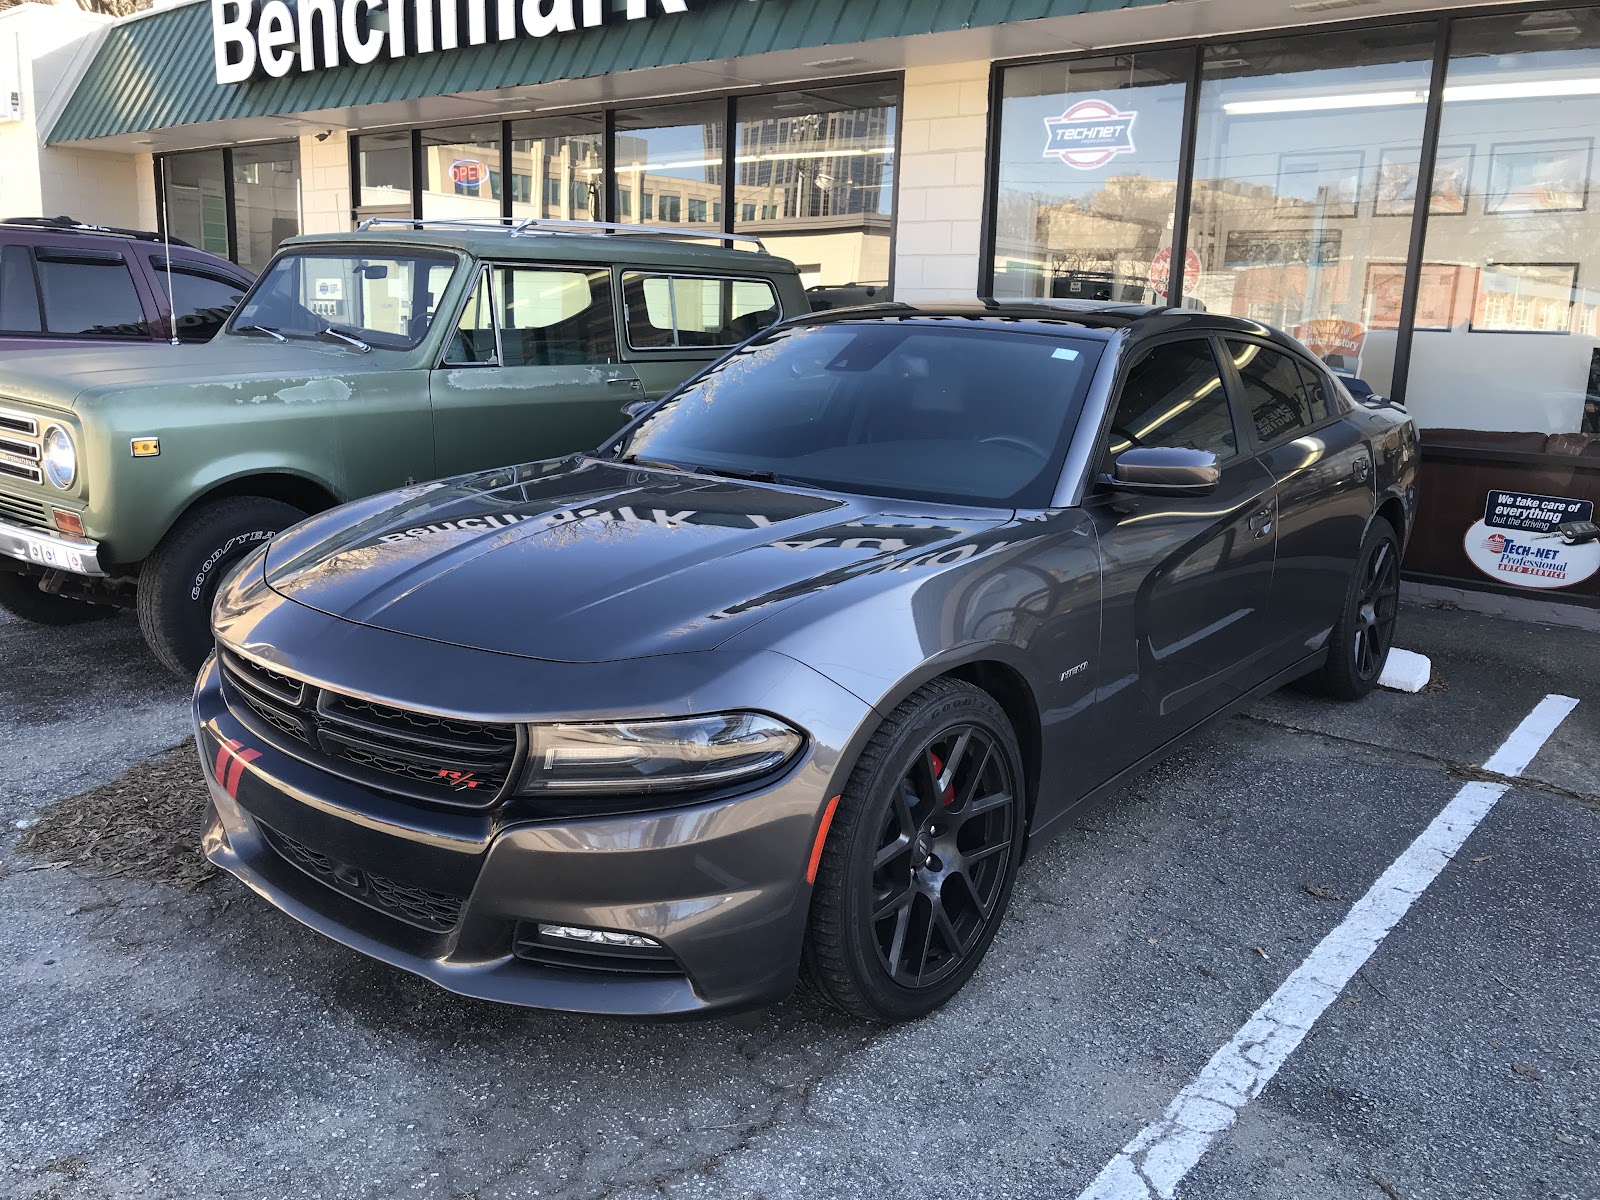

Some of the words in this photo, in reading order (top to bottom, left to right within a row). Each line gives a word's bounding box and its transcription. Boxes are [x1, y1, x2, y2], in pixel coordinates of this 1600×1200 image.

[212, 0, 688, 85] Benchma
[452, 163, 485, 182] OPEN
[1329, 336, 1360, 352] History
[1497, 494, 1514, 505] We
[1515, 497, 1539, 508] take
[1541, 501, 1566, 511] care
[1567, 503, 1581, 512] of
[1492, 515, 1506, 525] but
[1507, 516, 1521, 526] the
[1522, 519, 1550, 531] driving
[1495, 505, 1562, 523] everything
[192, 531, 276, 600] GOODYEA
[1499, 564, 1523, 574] AUTO
[1527, 567, 1565, 579] SERVICE
[1500, 553, 1568, 572] Professional
[438, 769, 479, 788] R/T
